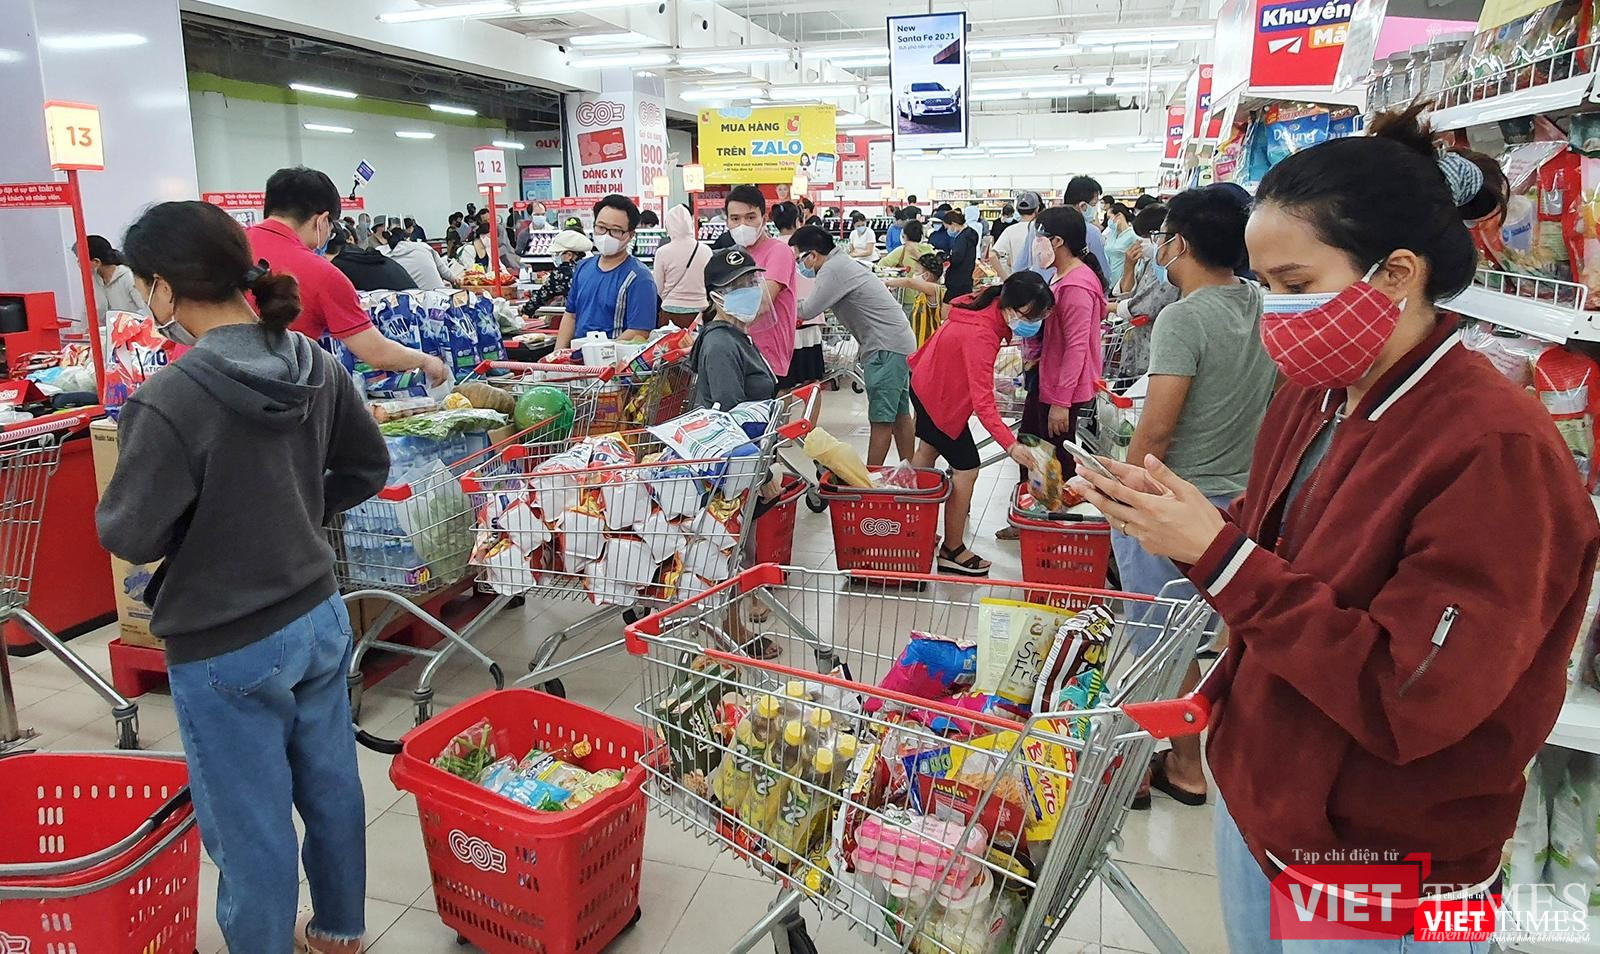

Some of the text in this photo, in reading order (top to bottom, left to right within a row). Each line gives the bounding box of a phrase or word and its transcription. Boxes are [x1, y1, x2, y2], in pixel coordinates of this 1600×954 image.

[1262, 0, 1351, 27] Khuyến
[898, 34, 921, 43] Santa
[935, 32, 955, 41] 2021
[1313, 26, 1347, 46] Mã
[721, 121, 780, 132] MUA HÀNG
[66, 126, 92, 147] 13
[641, 144, 662, 164] 1900
[716, 140, 802, 156] TRÊN ZALO
[478, 161, 485, 173] 12
[491, 161, 502, 172] 12
[608, 182, 623, 193] PHÍ
[1018, 641, 1042, 669] Str
